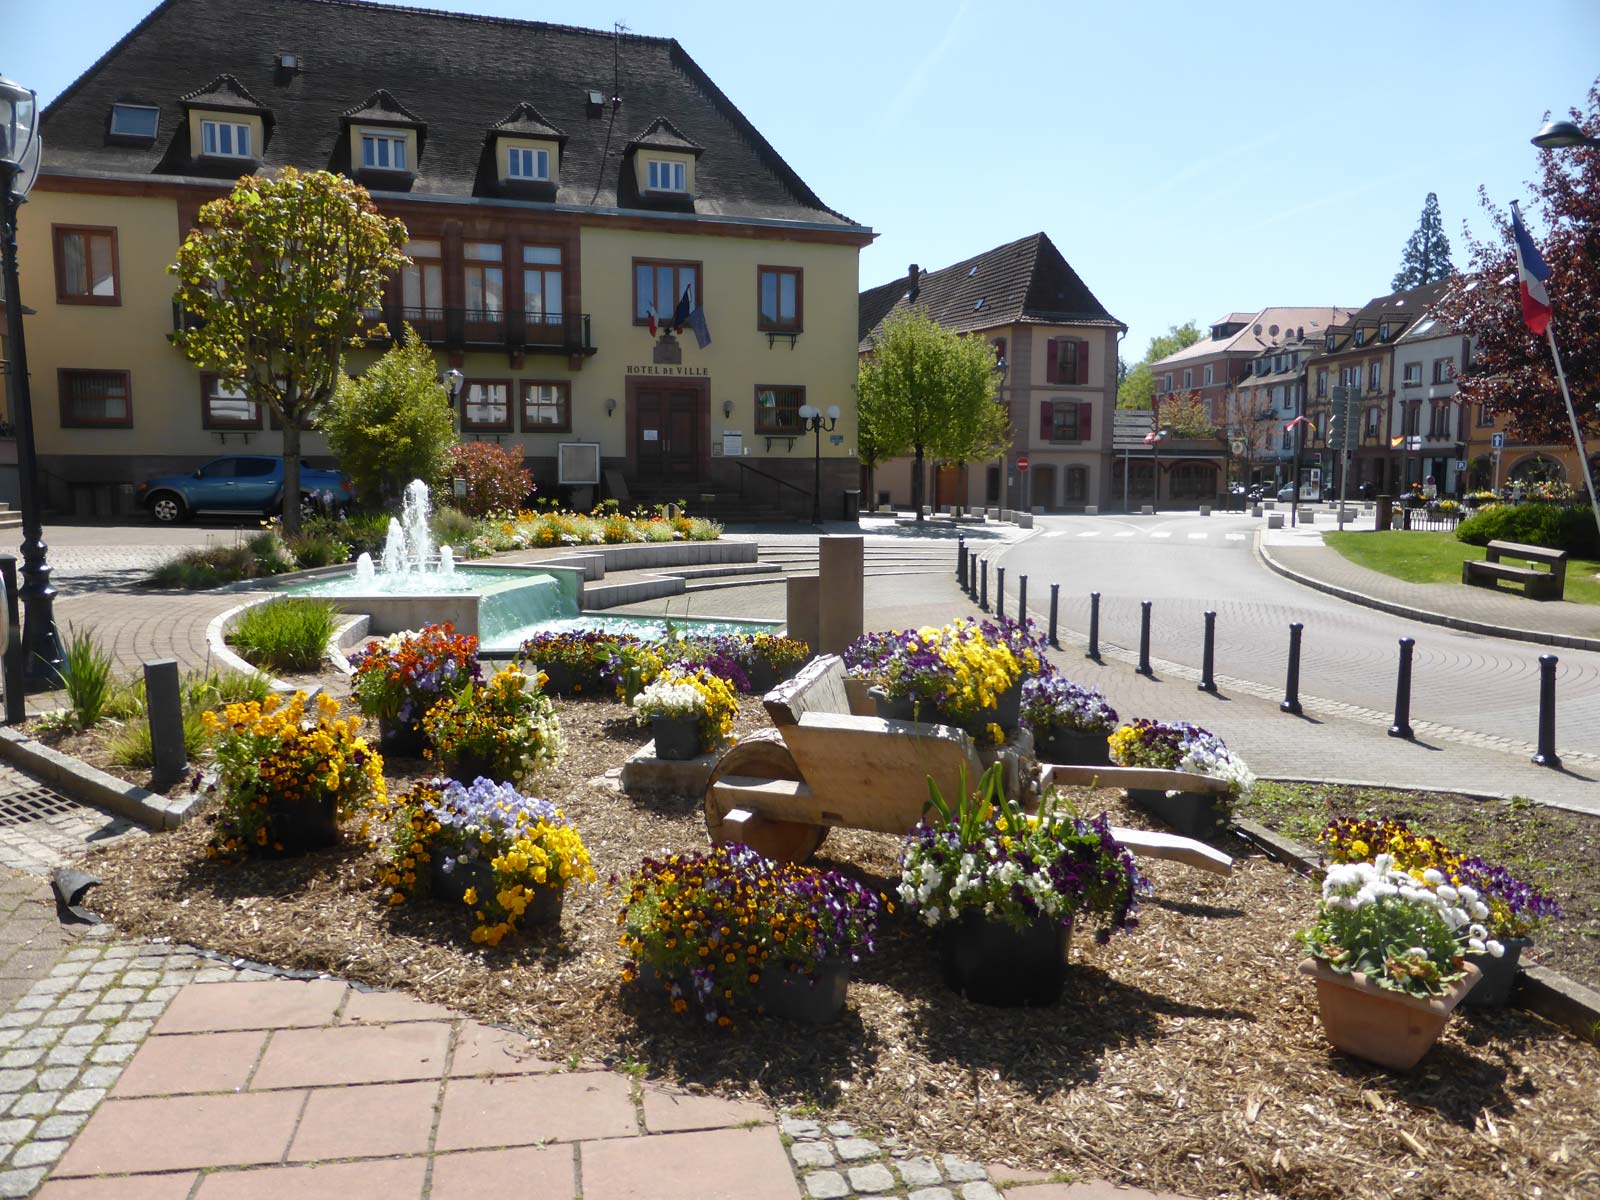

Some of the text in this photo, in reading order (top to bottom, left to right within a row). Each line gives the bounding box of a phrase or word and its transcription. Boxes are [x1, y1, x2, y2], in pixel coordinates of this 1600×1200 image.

[626, 365, 709, 376] HOTEL DE VILLE
